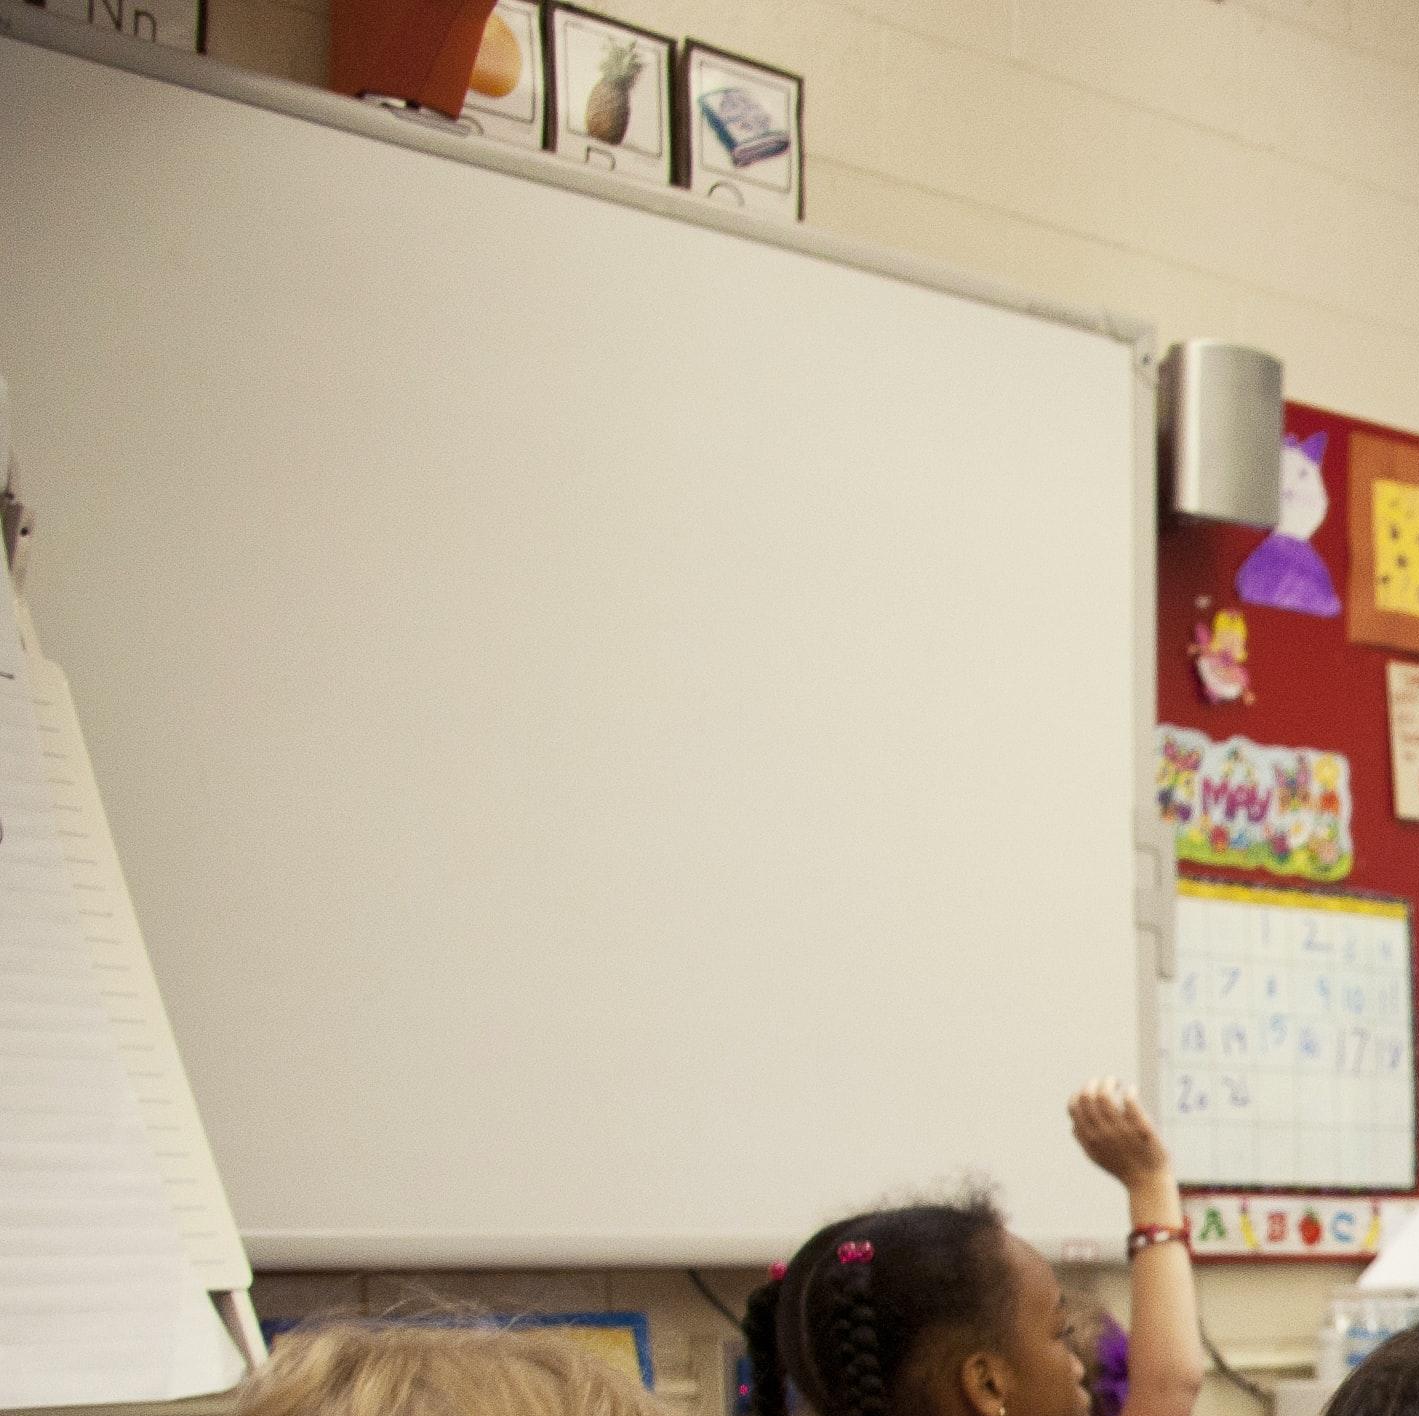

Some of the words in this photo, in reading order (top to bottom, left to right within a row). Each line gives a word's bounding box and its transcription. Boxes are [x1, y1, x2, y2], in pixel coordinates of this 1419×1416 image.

[1198, 1206, 1228, 1242] A
[1266, 1210, 1289, 1243] B
[1331, 1209, 1356, 1244] C
